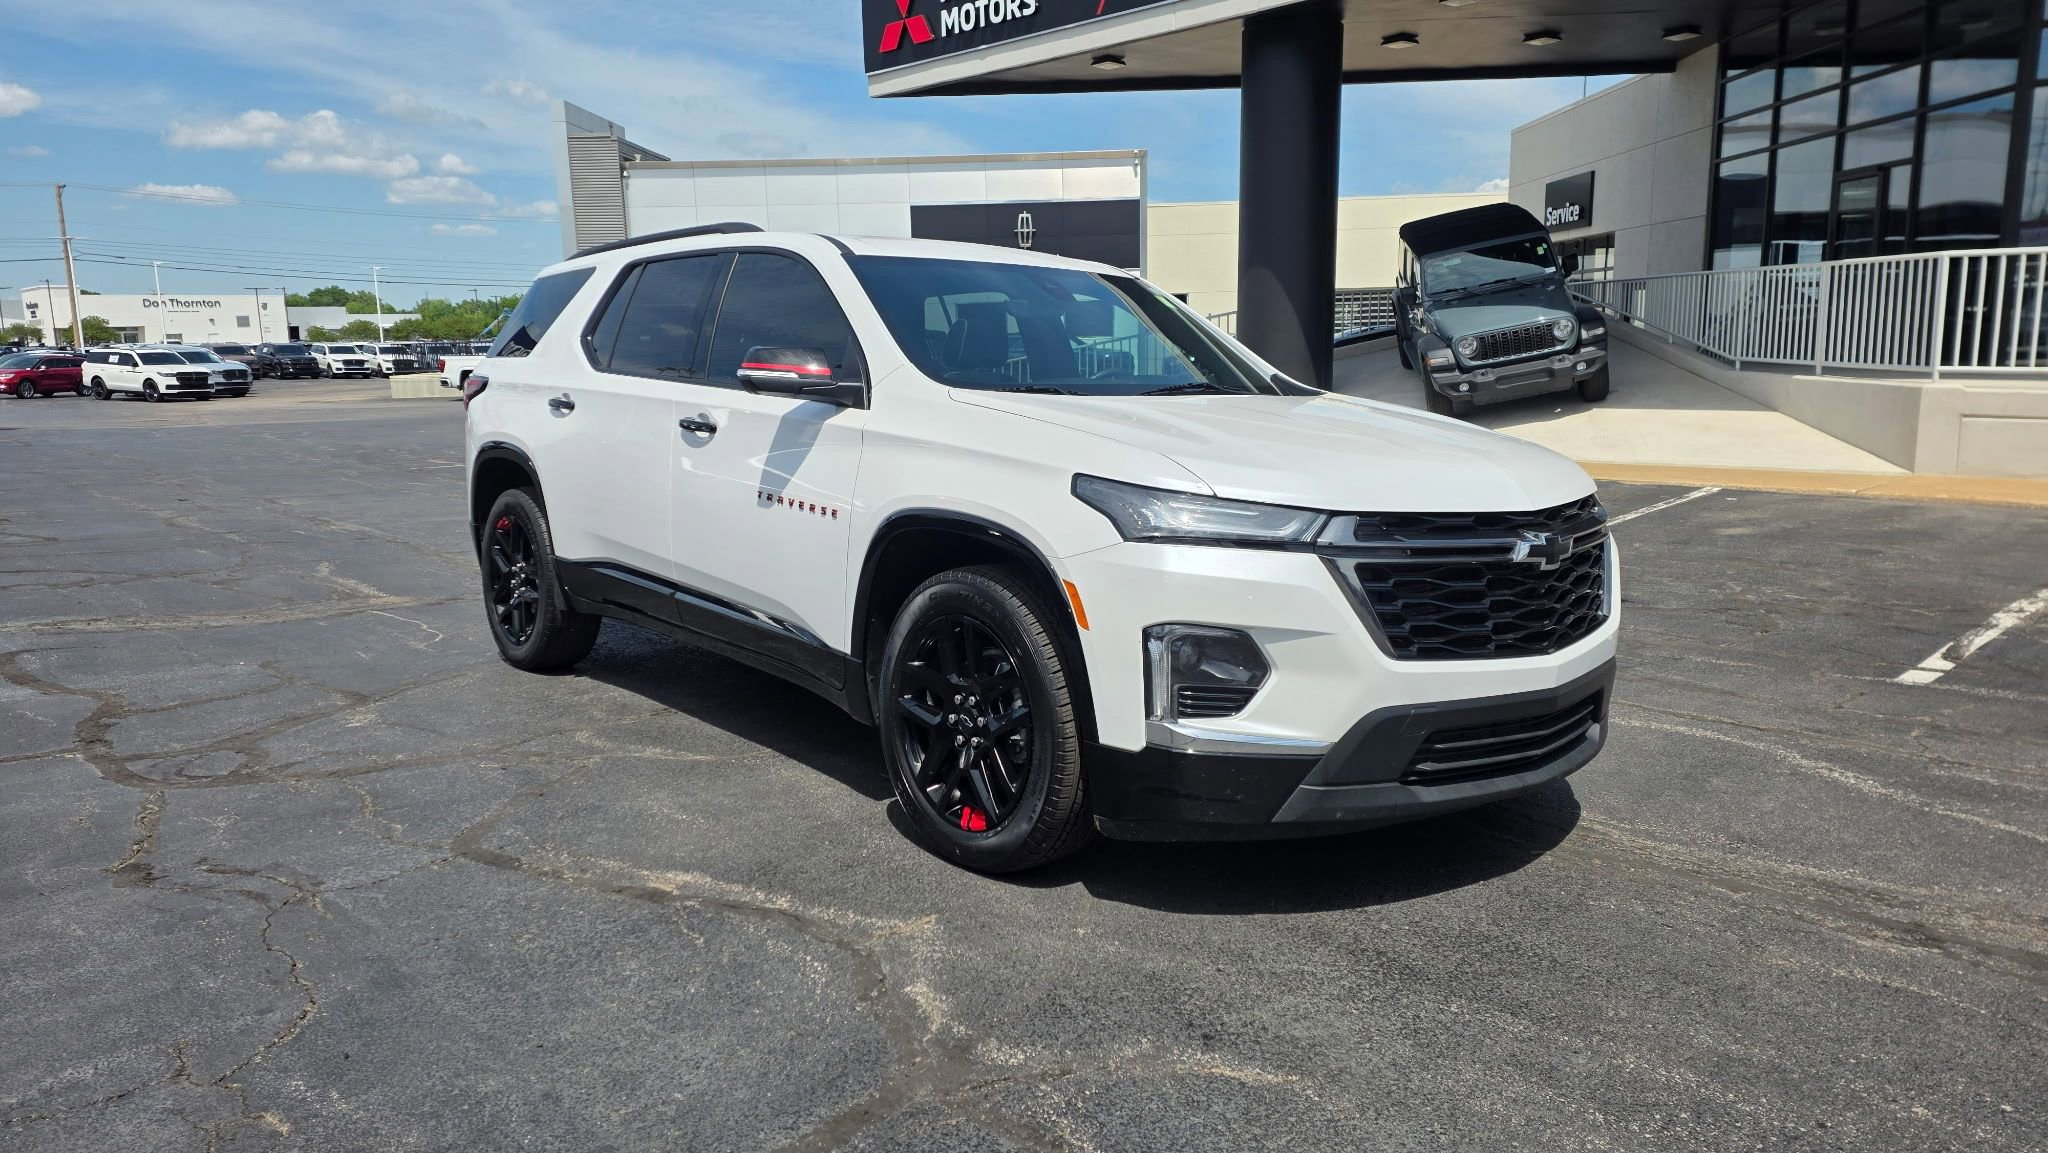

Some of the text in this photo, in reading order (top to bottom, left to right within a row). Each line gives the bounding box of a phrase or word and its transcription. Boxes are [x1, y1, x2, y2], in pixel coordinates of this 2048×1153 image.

[939, 0, 1036, 37] MOTORS
[1546, 201, 1580, 227] Service
[142, 298, 221, 308] Don Thornton
[757, 490, 839, 519] TRAVERSE
